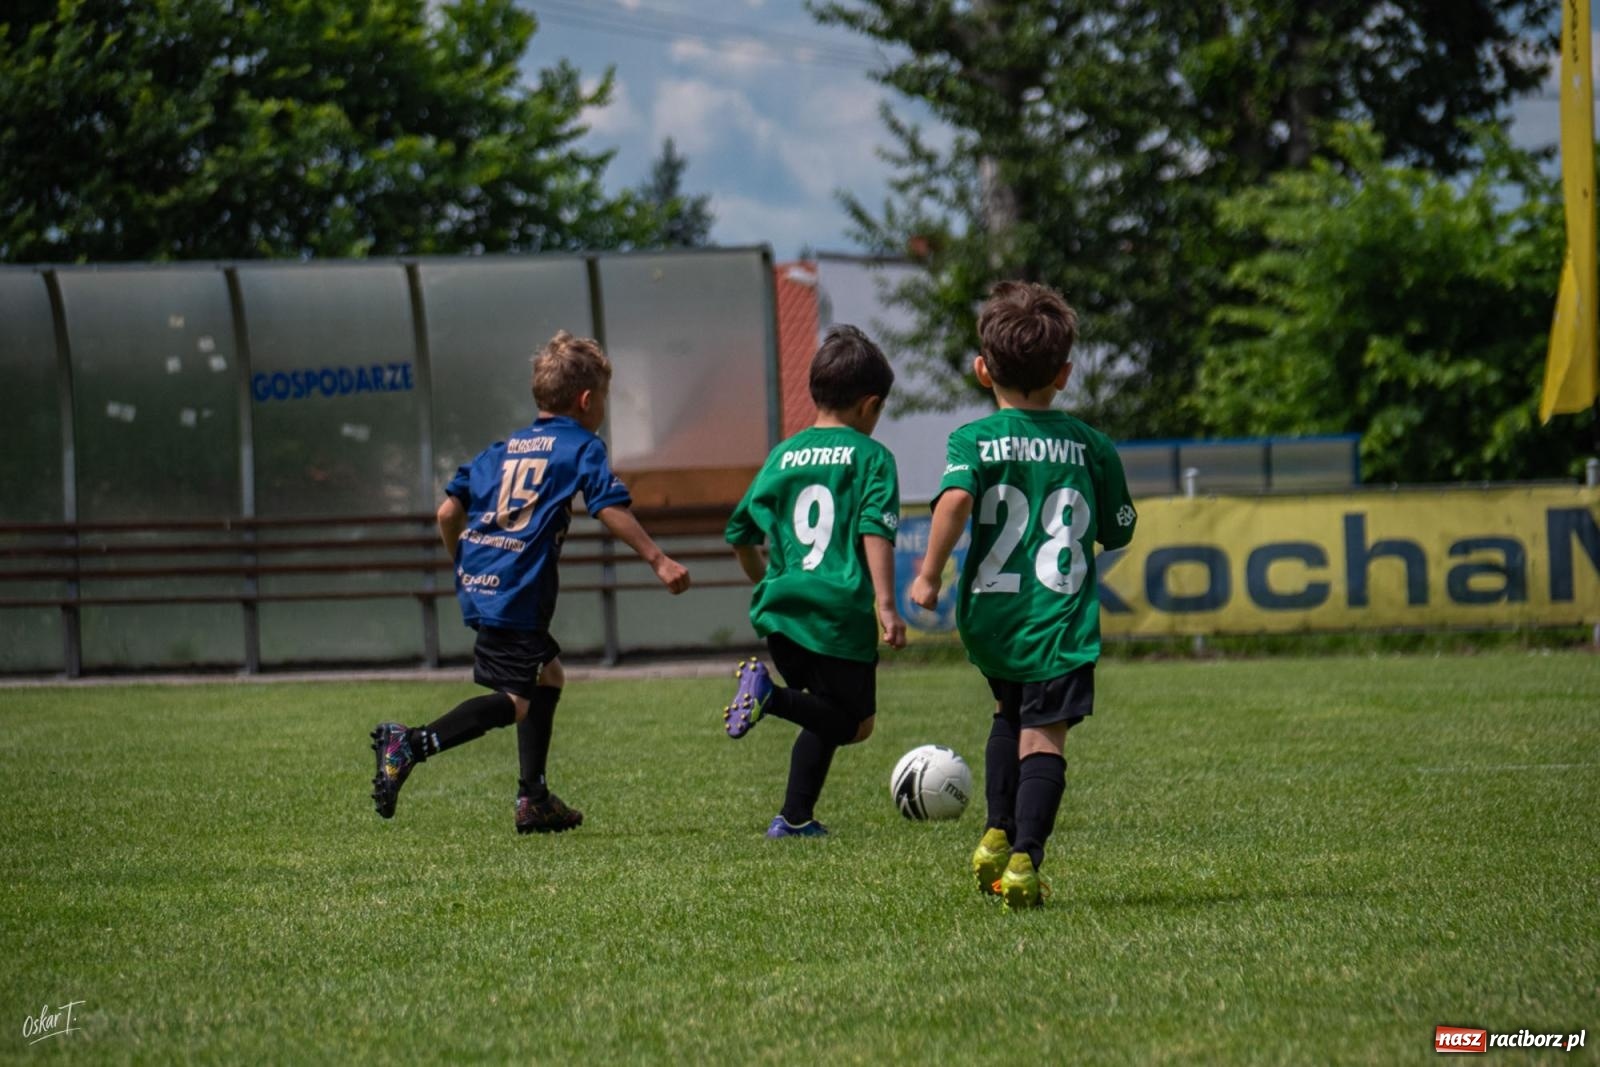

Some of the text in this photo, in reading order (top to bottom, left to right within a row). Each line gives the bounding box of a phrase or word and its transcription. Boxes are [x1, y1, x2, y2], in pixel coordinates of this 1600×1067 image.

[253, 361, 415, 403] GOSPODARZE
[781, 446, 856, 470] PIOTREK
[978, 436, 1087, 466] ZIEMOWIT
[793, 484, 835, 571] 9
[971, 484, 1091, 595] 28
